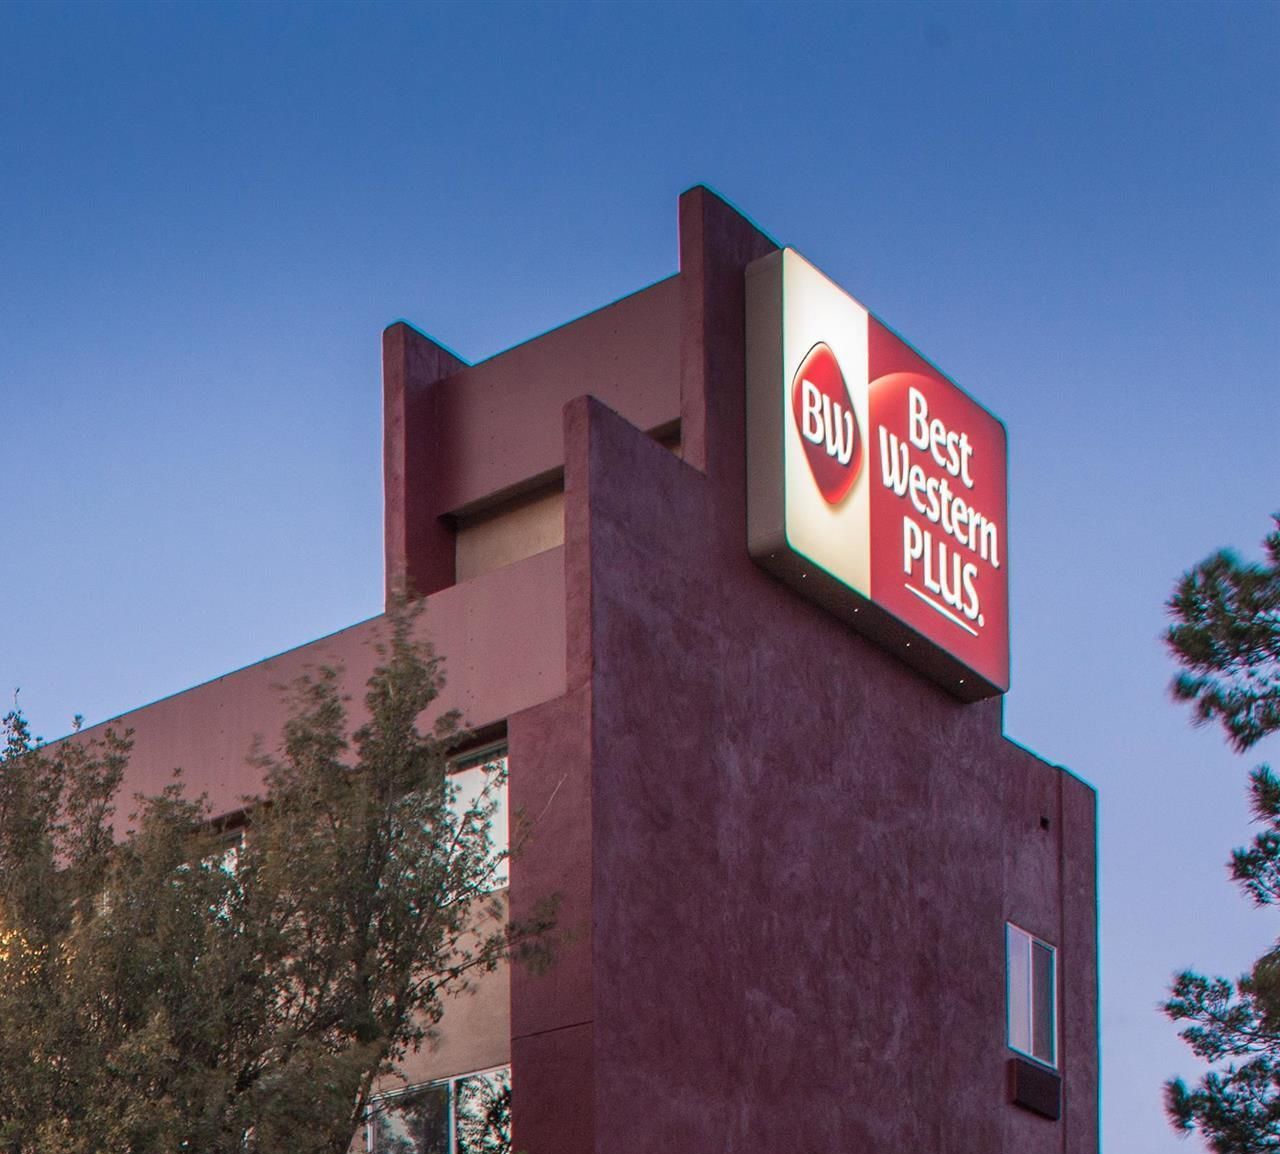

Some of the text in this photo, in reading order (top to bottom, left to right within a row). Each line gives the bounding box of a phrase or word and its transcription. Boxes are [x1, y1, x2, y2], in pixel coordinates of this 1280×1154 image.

[801, 379, 855, 466] BW
[908, 386, 974, 489] Best
[878, 424, 1000, 569] Western
